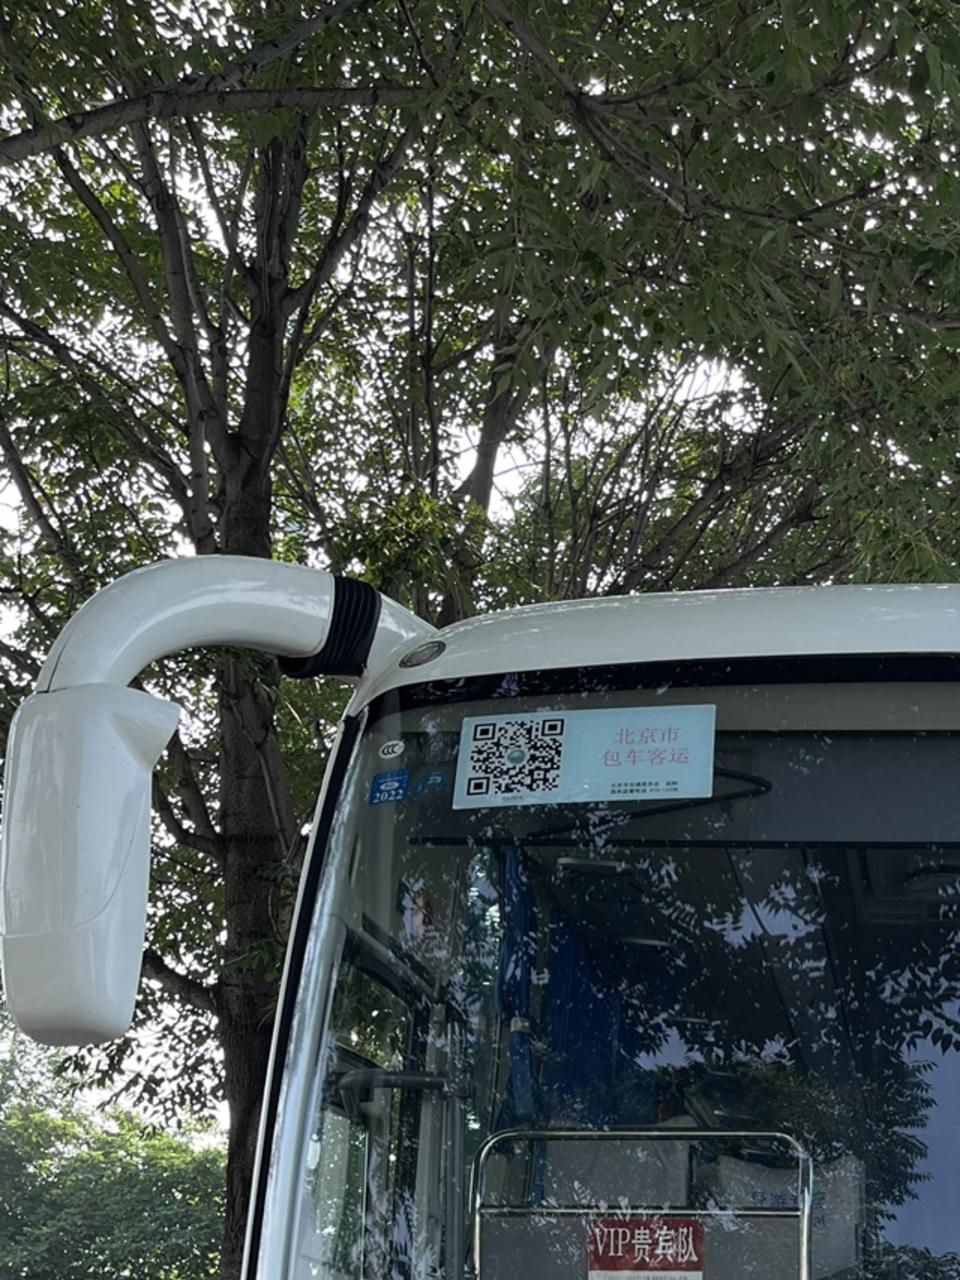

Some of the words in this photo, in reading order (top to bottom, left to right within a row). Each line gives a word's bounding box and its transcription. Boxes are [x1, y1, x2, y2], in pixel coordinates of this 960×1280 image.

[614, 726, 680, 744] 北京市
[601, 748, 689, 767] 包车客运
[372, 788, 404, 803] 2022
[595, 1226, 698, 1263] VIP贵宾队
